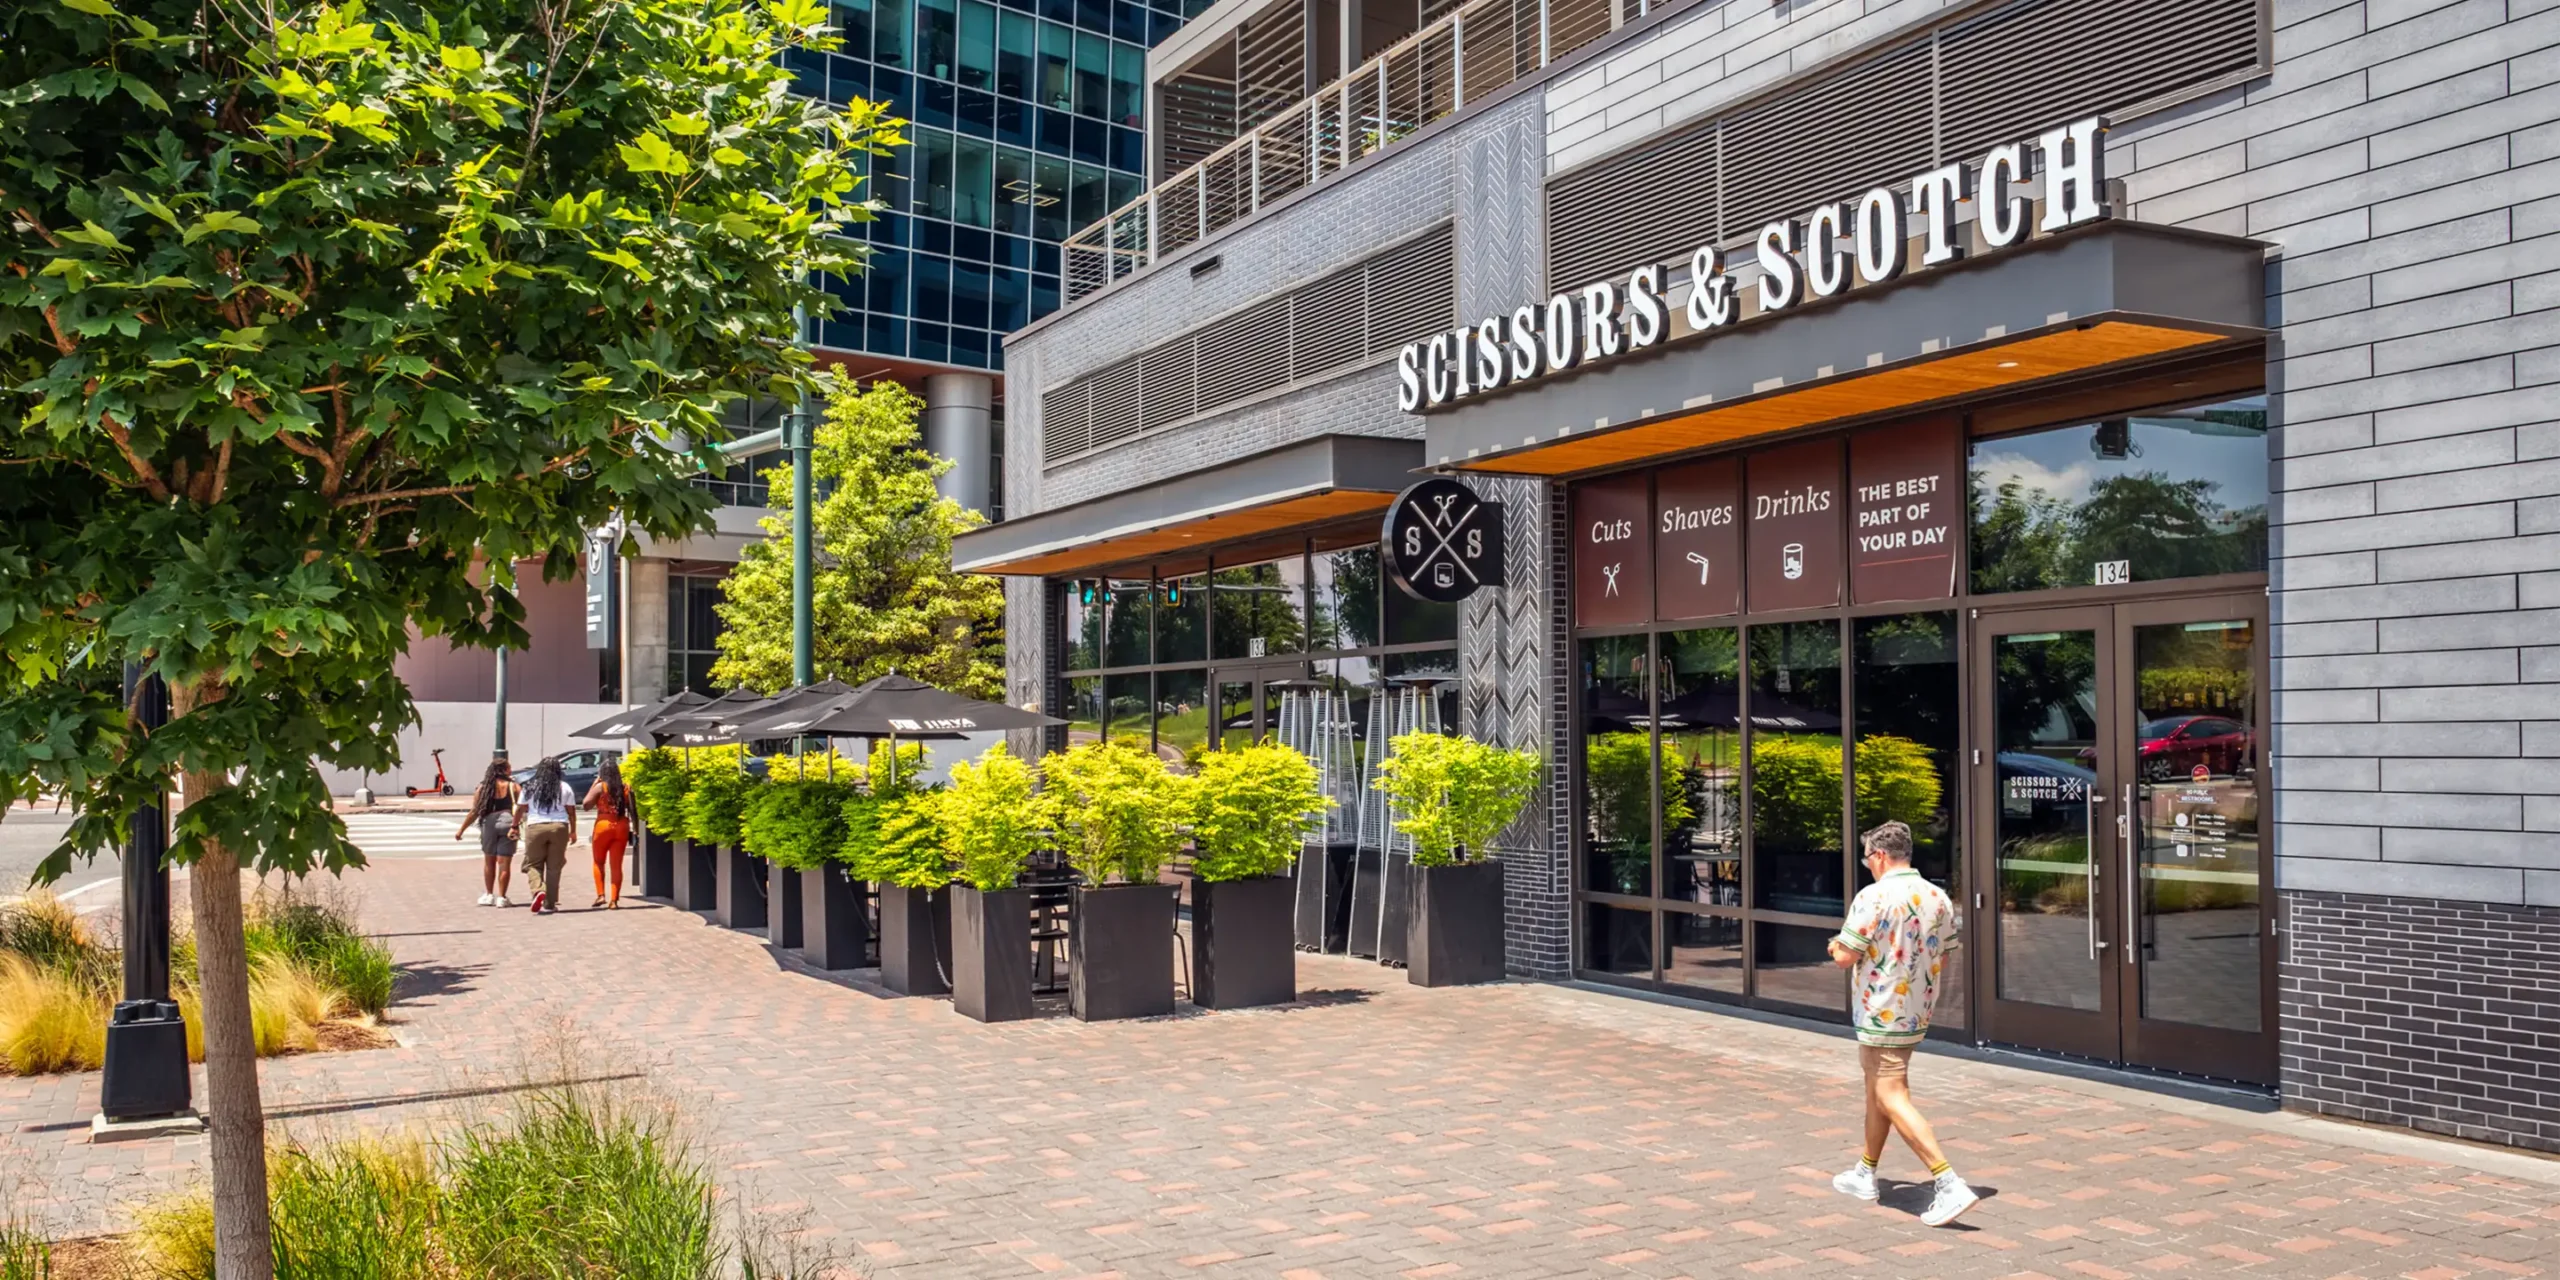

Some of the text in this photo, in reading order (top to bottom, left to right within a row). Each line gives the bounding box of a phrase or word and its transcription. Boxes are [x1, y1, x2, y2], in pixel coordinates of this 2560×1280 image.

[1398, 115, 2108, 412] SCISSORS & SCOTCH
[1858, 475, 1939, 503] THE BEST
[1755, 486, 1831, 520] Drinks
[1859, 502, 1930, 528] PART OF
[1592, 519, 1632, 544] Cuts
[1662, 505, 1733, 533] Shaves
[1405, 526, 1483, 558] S S
[1859, 526, 1948, 552] YOUR DAY
[2098, 561, 2128, 583] 134
[1251, 638, 1264, 656] 132
[2010, 776, 2058, 787] SCISSORS
[2011, 788, 2058, 799] & SCOTCH
